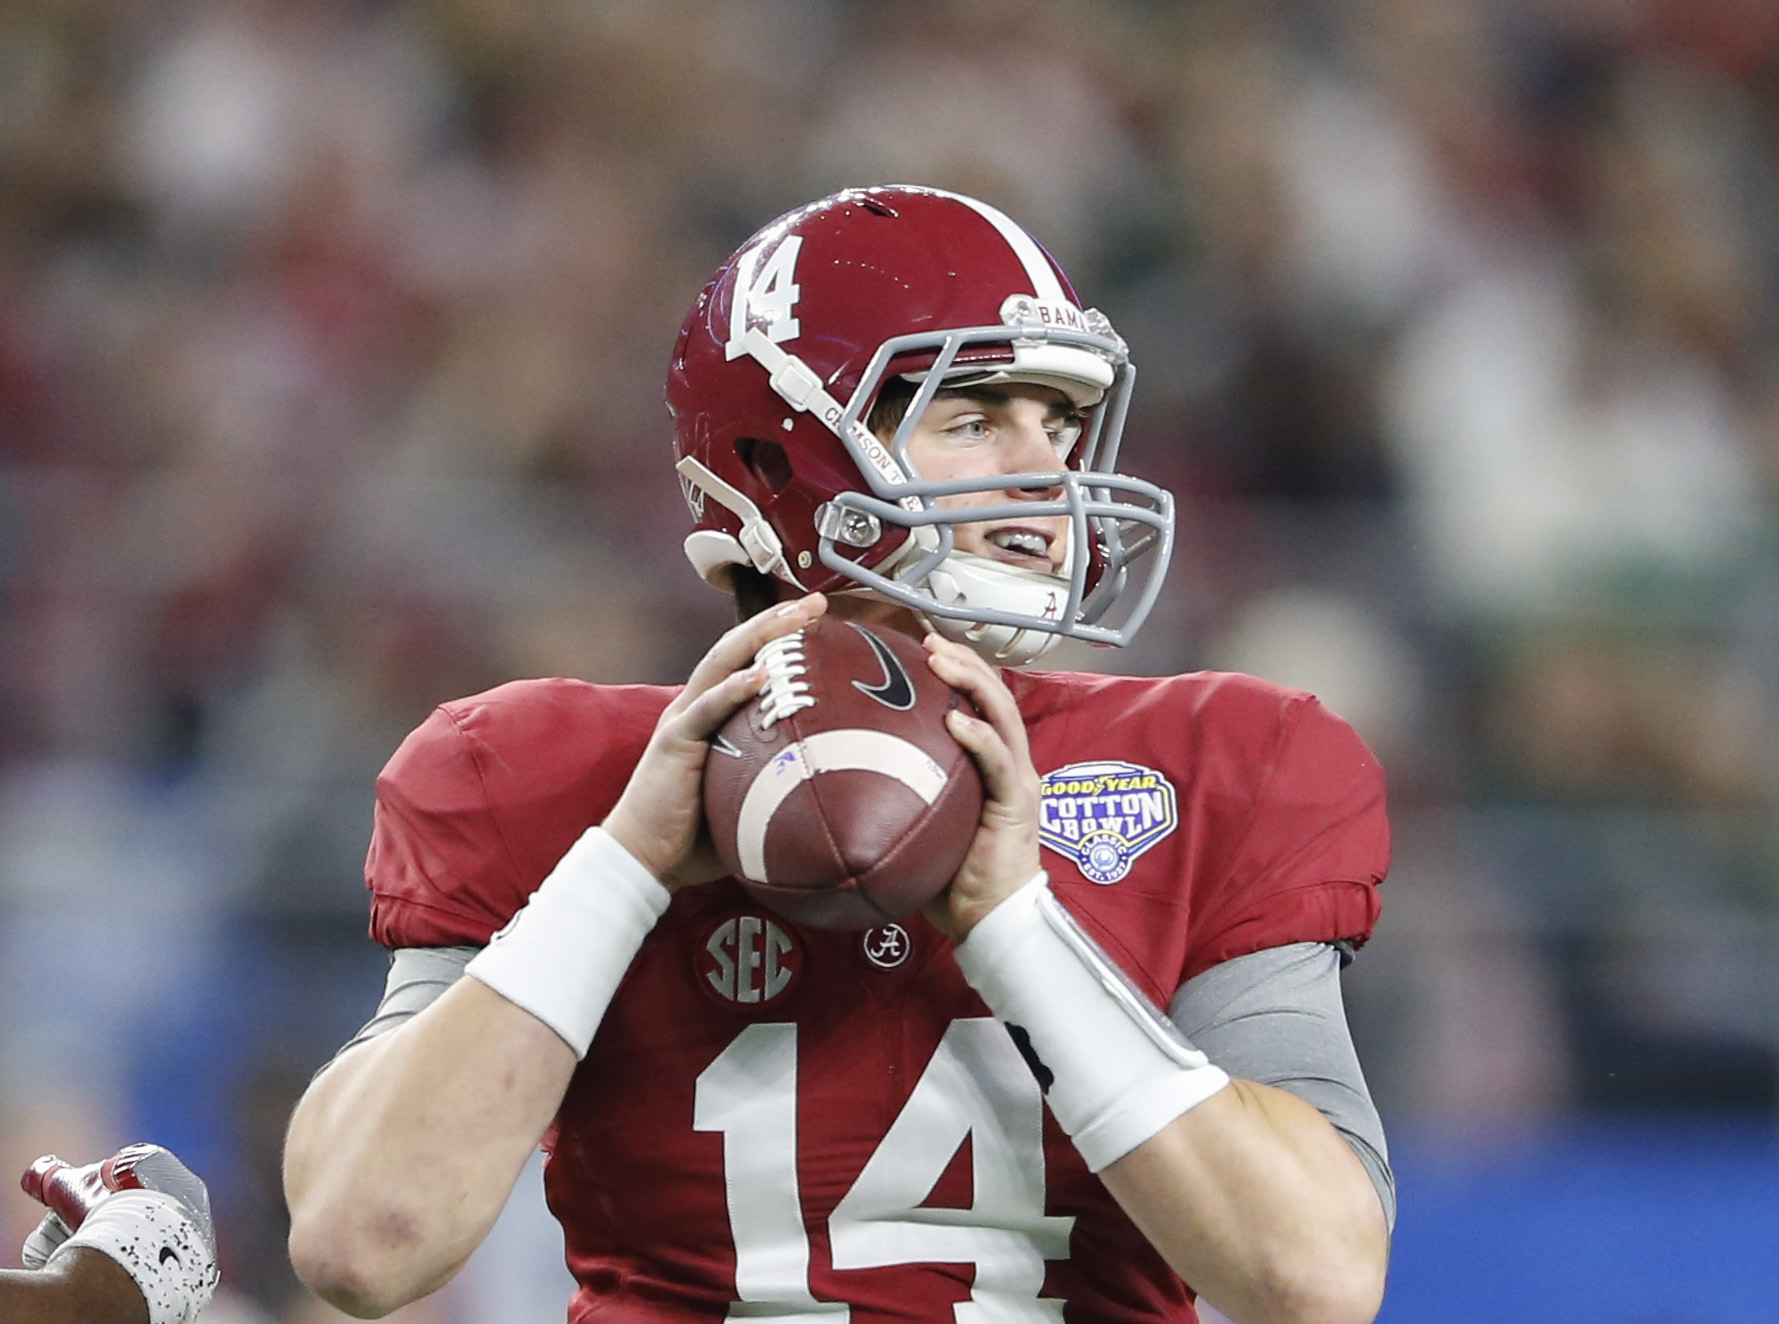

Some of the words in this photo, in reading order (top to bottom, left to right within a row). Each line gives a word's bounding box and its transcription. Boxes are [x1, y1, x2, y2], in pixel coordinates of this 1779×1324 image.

[725, 234, 804, 362] 14
[825, 407, 891, 470] CSON
[1039, 791, 1164, 835] COTTON
[1061, 816, 1142, 841] BOWL
[1081, 834, 1127, 855] CLASSIC
[706, 916, 793, 1003] SEC
